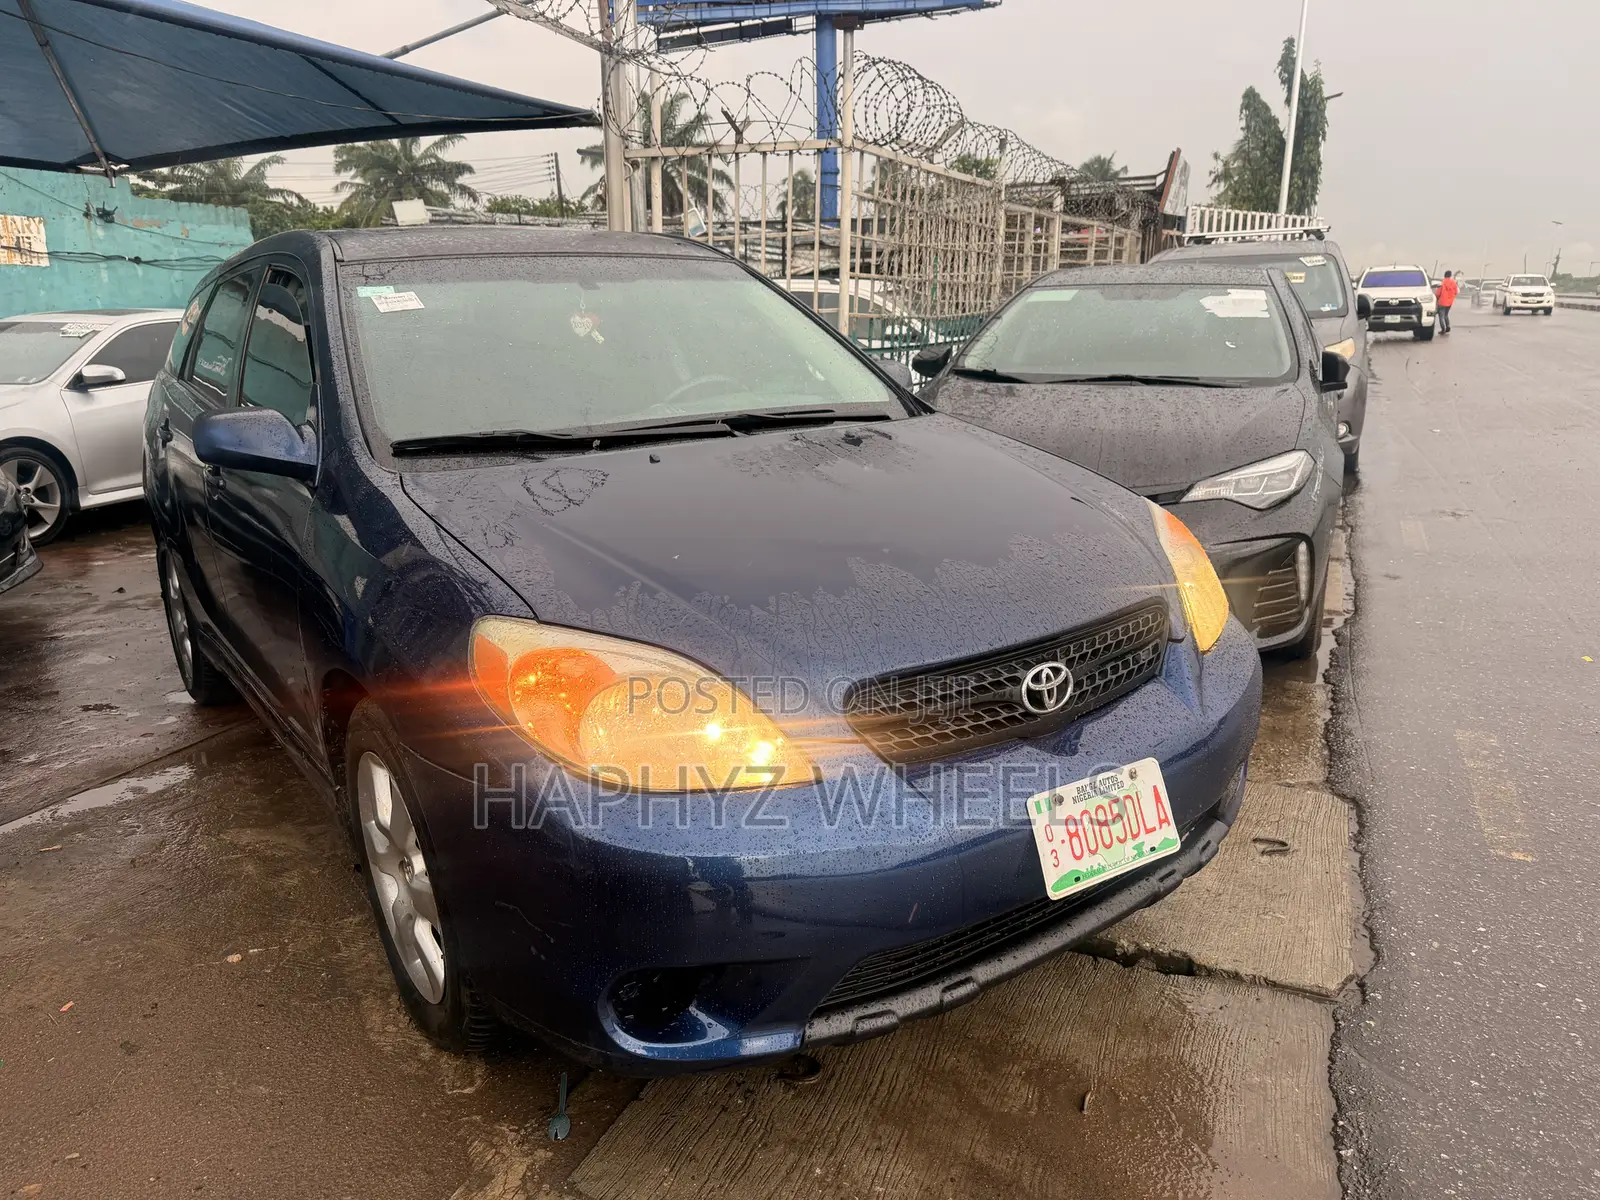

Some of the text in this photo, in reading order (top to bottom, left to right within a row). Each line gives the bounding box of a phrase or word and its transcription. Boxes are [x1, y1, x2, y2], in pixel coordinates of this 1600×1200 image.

[1098, 774, 1119, 788] AUTOS
[1072, 780, 1125, 805] NIGERIA LIMITED
